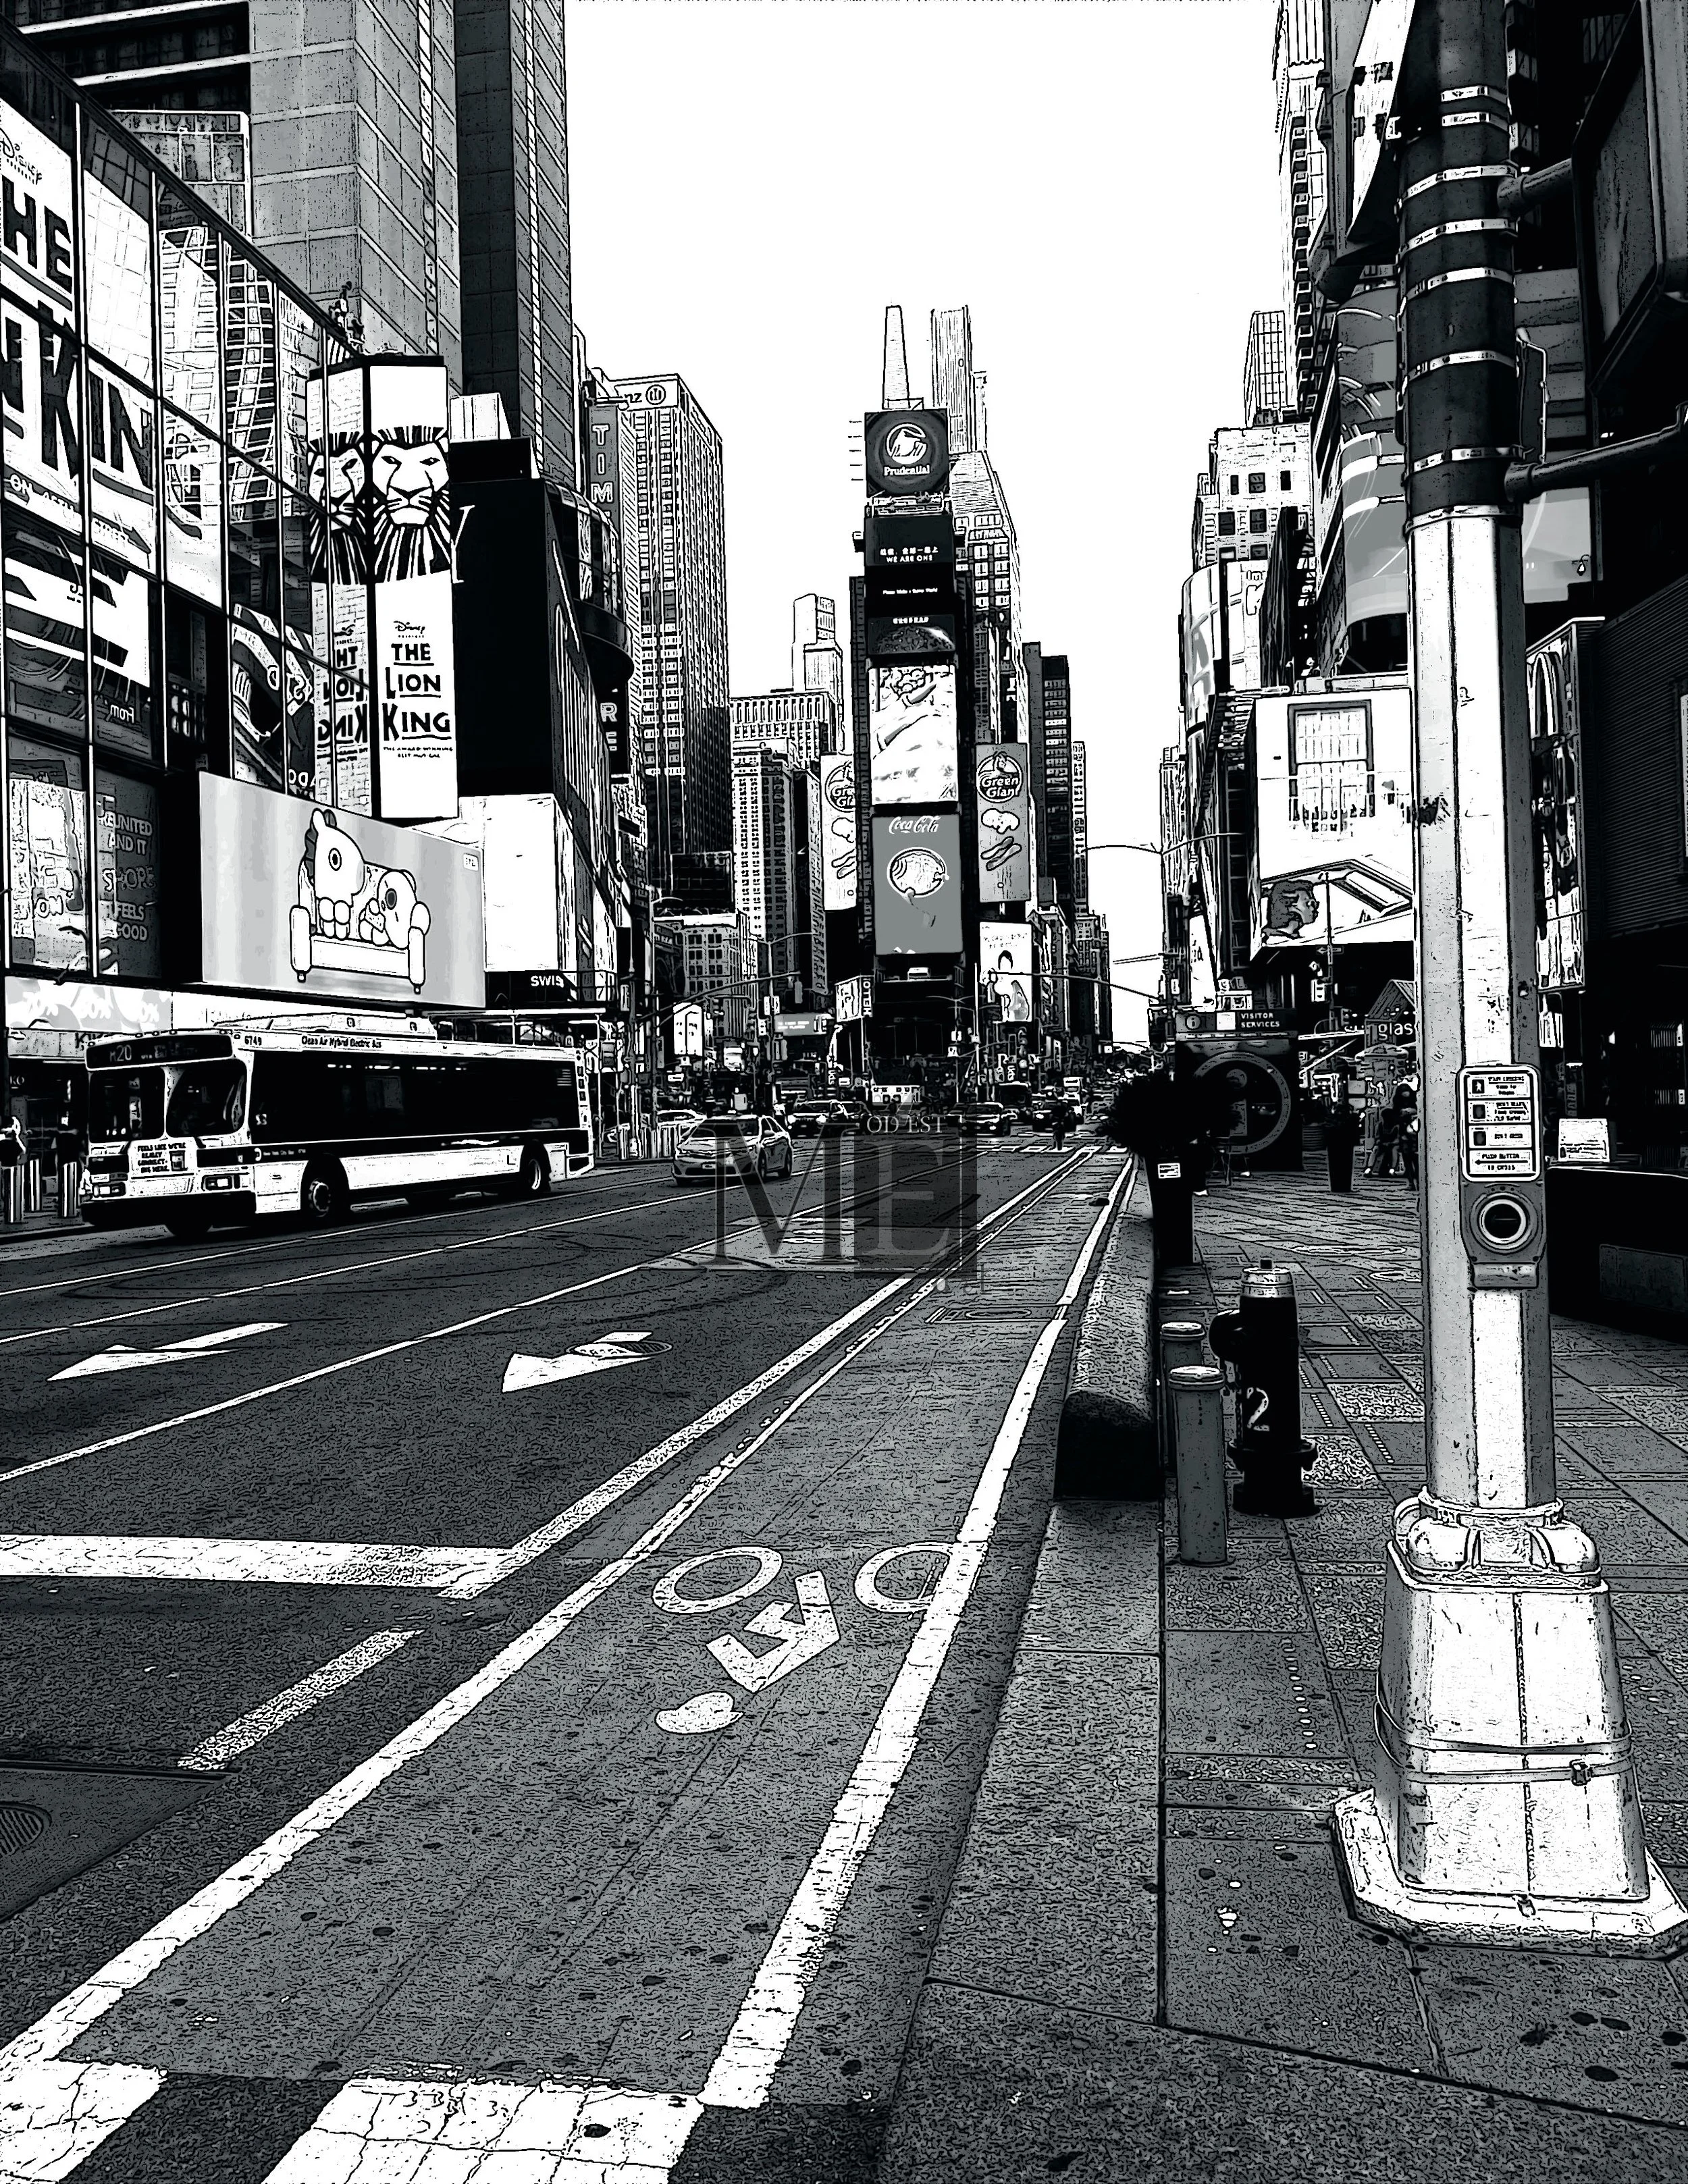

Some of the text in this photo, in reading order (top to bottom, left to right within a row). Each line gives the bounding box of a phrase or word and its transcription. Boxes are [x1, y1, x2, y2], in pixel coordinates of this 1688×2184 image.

[1, 174, 73, 294] HE
[883, 464, 930, 476] Prudential
[393, 620, 425, 634] Disney
[391, 643, 431, 661] THE
[385, 667, 441, 699] LION
[382, 703, 451, 741] KING
[981, 777, 1019, 789] Green
[986, 784, 1020, 799] Giant
[136, 838, 148, 855] IT
[1240, 1020, 1280, 1028] SERVICES
[1378, 1021, 1417, 1041] glas
[1246, 1387, 1270, 1432] 2
